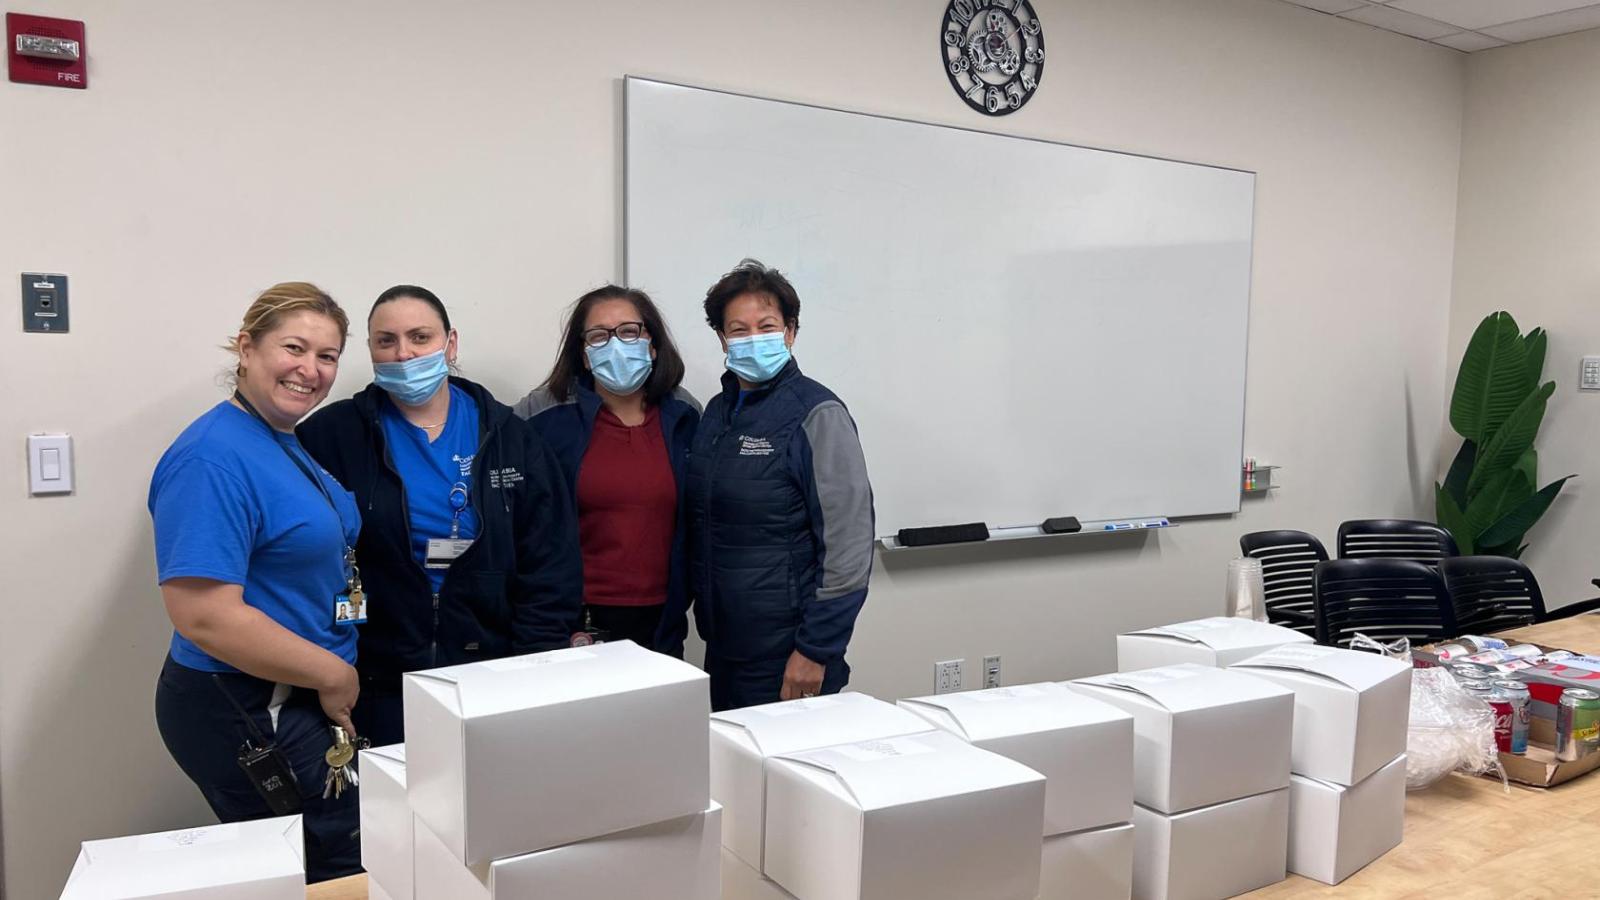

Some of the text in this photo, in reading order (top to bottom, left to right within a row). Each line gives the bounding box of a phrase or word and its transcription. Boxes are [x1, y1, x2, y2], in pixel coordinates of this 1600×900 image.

[944, 30, 966, 48] 9
[1020, 19, 1041, 40] 2
[949, 56, 970, 76] 8
[1025, 47, 1045, 64] 3
[57, 72, 81, 83] FIRE
[965, 74, 985, 99] 7
[1020, 70, 1038, 92] 4
[986, 86, 1000, 113] 6
[1005, 82, 1021, 109] 5
